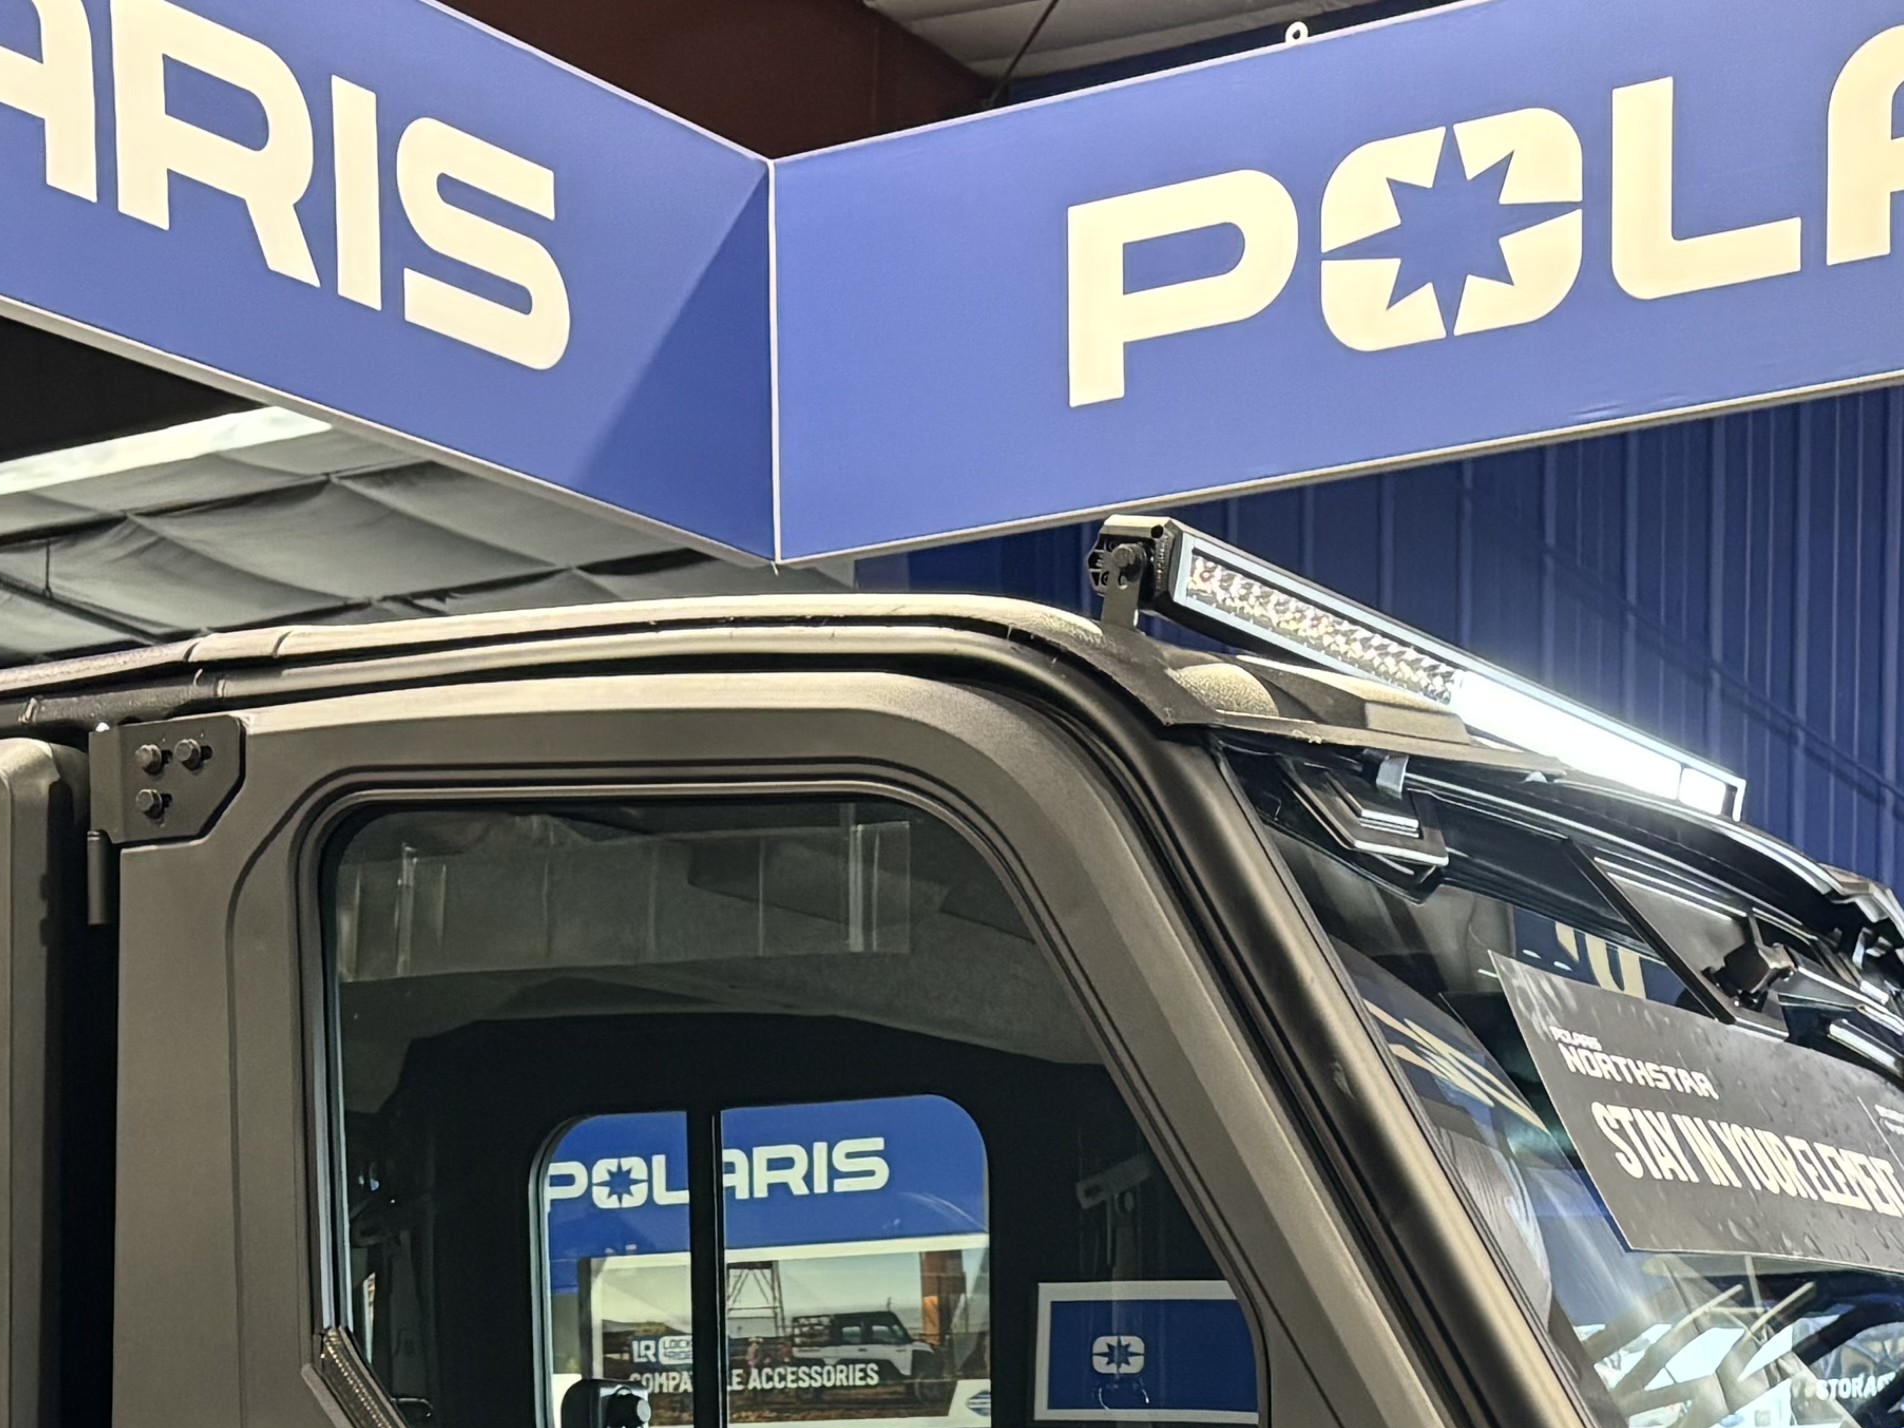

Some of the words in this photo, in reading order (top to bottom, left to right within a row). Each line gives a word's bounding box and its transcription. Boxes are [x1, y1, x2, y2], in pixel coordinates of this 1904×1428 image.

[1557, 1042, 1720, 1100] NORTHSTAR
[547, 1137, 890, 1212] POLARIS
[1591, 1101, 1700, 1183] STAY
[1672, 1113, 1742, 1188] IN
[1708, 1119, 1818, 1201] YOUR
[748, 1363, 880, 1390] ACCESSORIES
